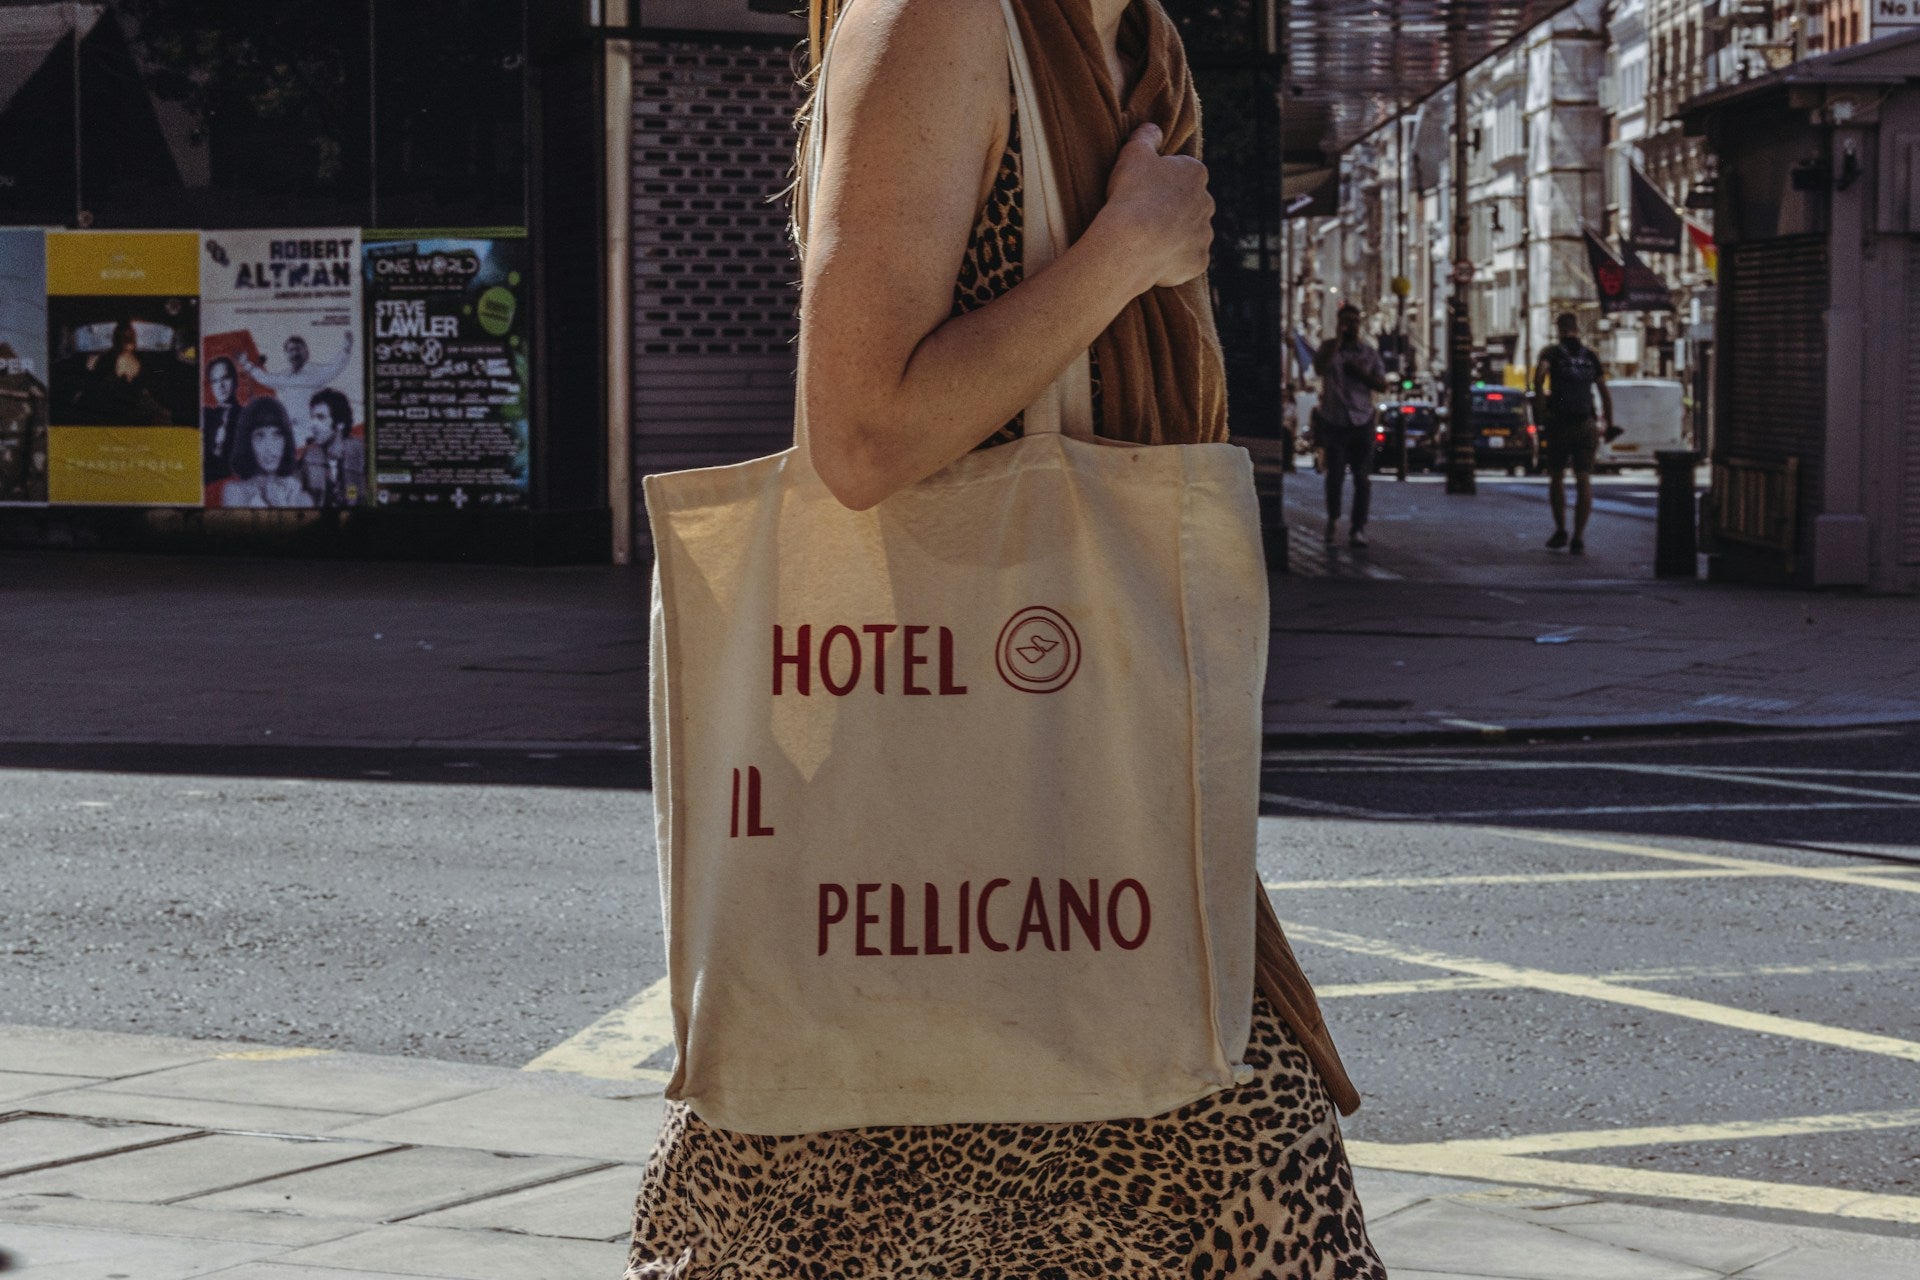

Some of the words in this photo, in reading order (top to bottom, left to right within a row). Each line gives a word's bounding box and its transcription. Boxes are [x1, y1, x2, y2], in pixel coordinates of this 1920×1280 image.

[269, 239, 353, 259] ROBERT
[235, 262, 351, 288] ALTMAN
[375, 257, 411, 275] ONE
[375, 300, 426, 317] STEVE
[375, 315, 459, 339] LAWLER
[772, 623, 967, 697] HOTEL
[730, 766, 775, 838] IL
[818, 877, 1152, 956] PELLICANO
